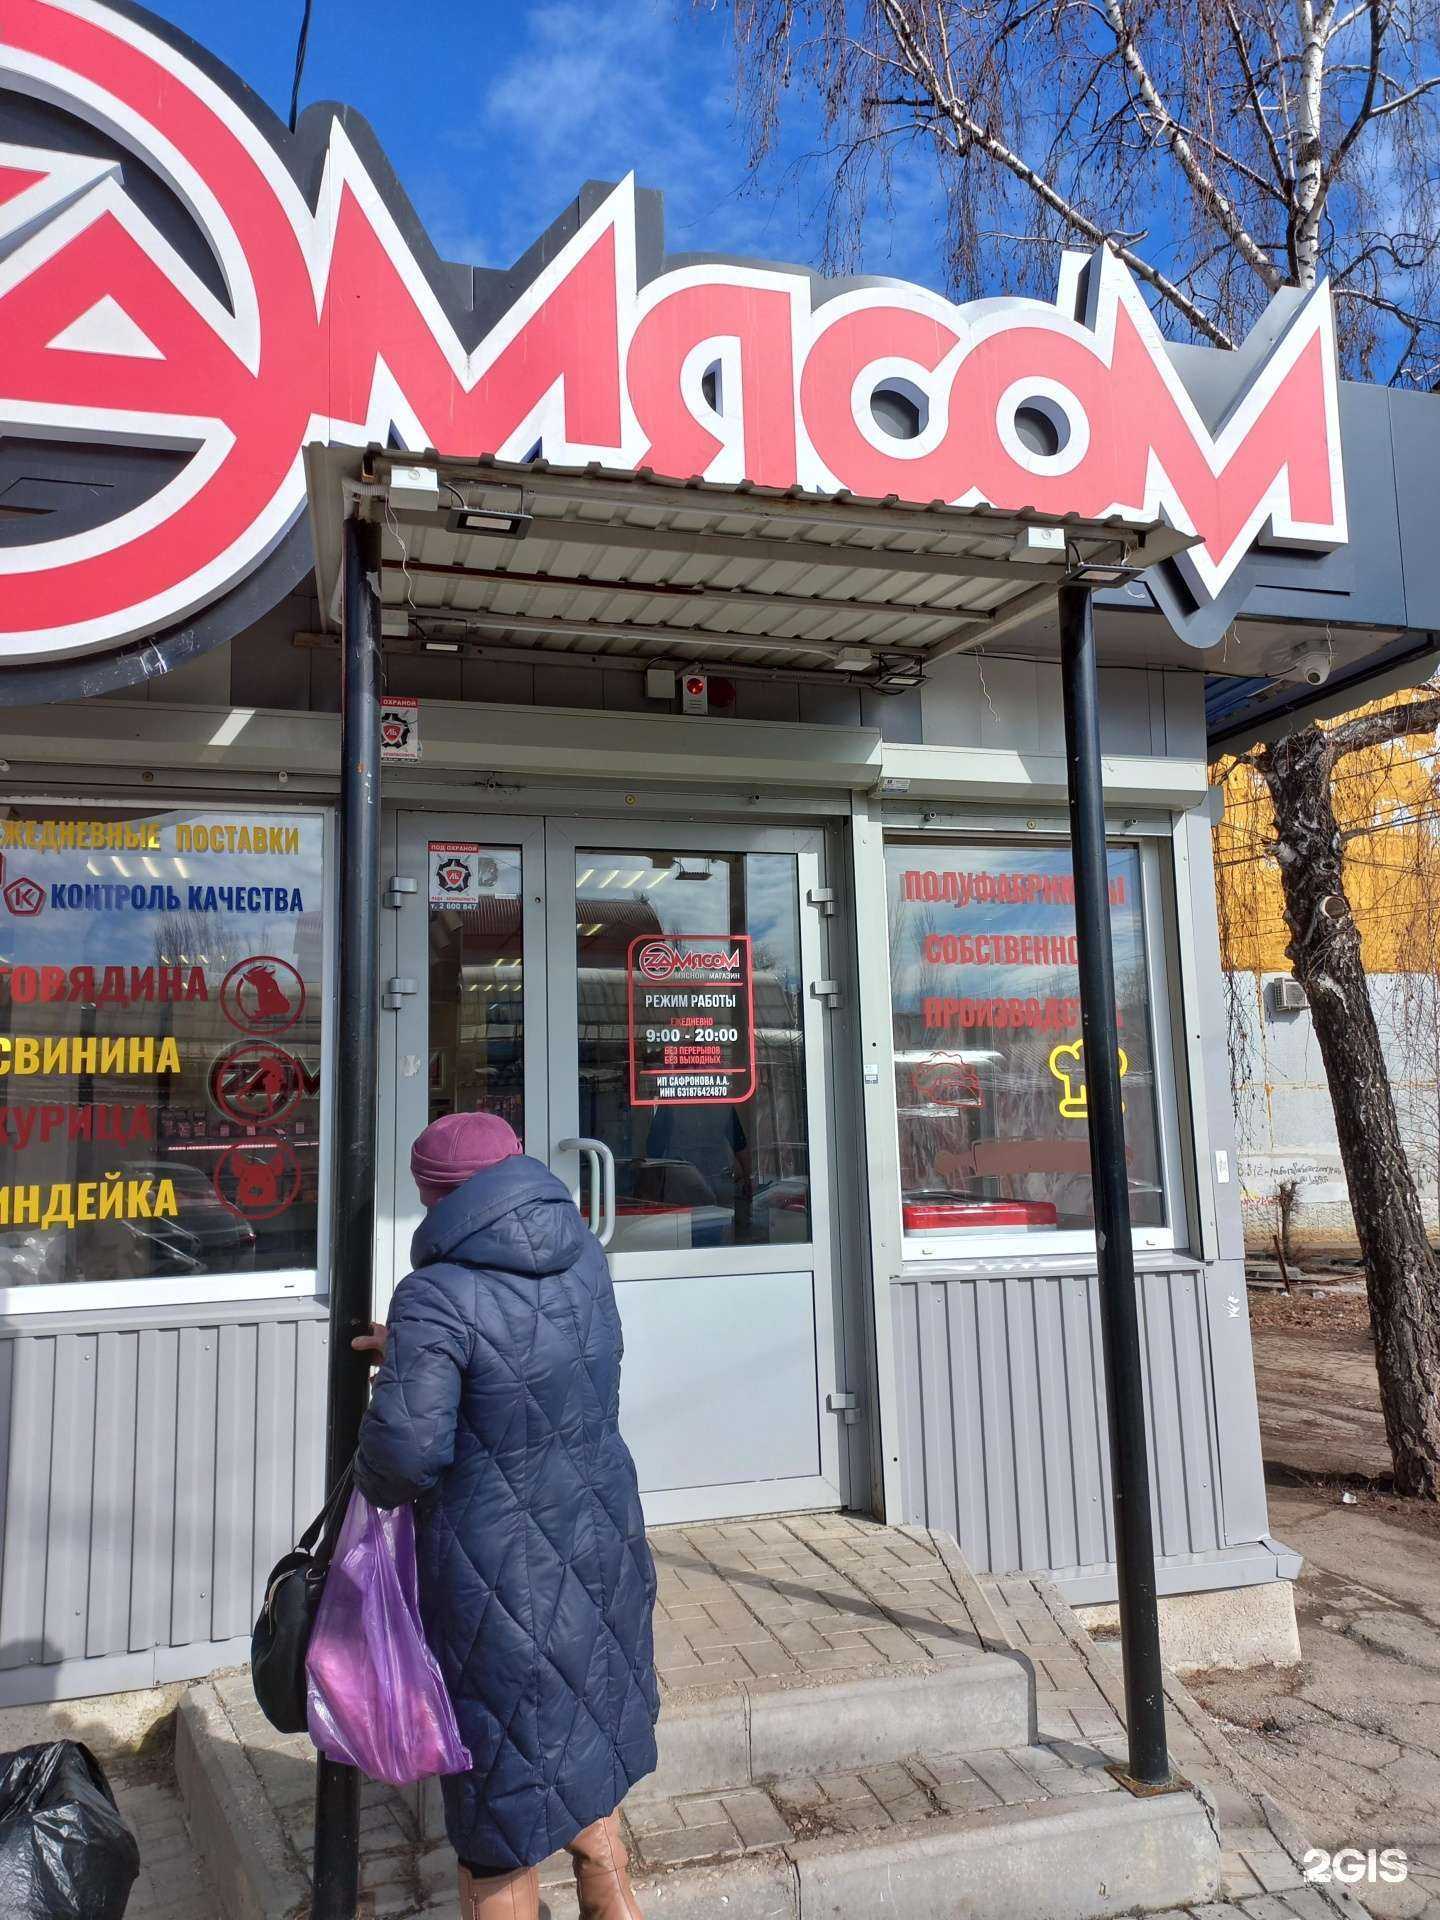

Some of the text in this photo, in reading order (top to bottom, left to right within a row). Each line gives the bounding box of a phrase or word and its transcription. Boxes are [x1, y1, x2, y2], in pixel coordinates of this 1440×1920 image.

[176, 823, 301, 855] ПОСТАВКИ
[904, 871, 1126, 907] ПОЛУФАБРИКЫ
[51, 883, 304, 912] КОНТРОЛЬ КАЧЕСТВА
[709, 972, 740, 980] МАГАЗИН
[645, 994, 736, 1008] РЕЖИМ РАБОТЫ
[923, 996, 1124, 1033] ПРОИЗВОДС
[645, 1029, 680, 1042] 9:00
[694, 1029, 738, 1042] 20:00
[664, 1046, 721, 1055] БЕЗ ПЕРЕРЫВОВ
[664, 1055, 721, 1065] БЕЗ ВЫХОДНЫХ
[656, 1075, 730, 1087] ИП САФРОНОВА А.А.
[659, 1086, 727, 1097] ИНН 631876424870
